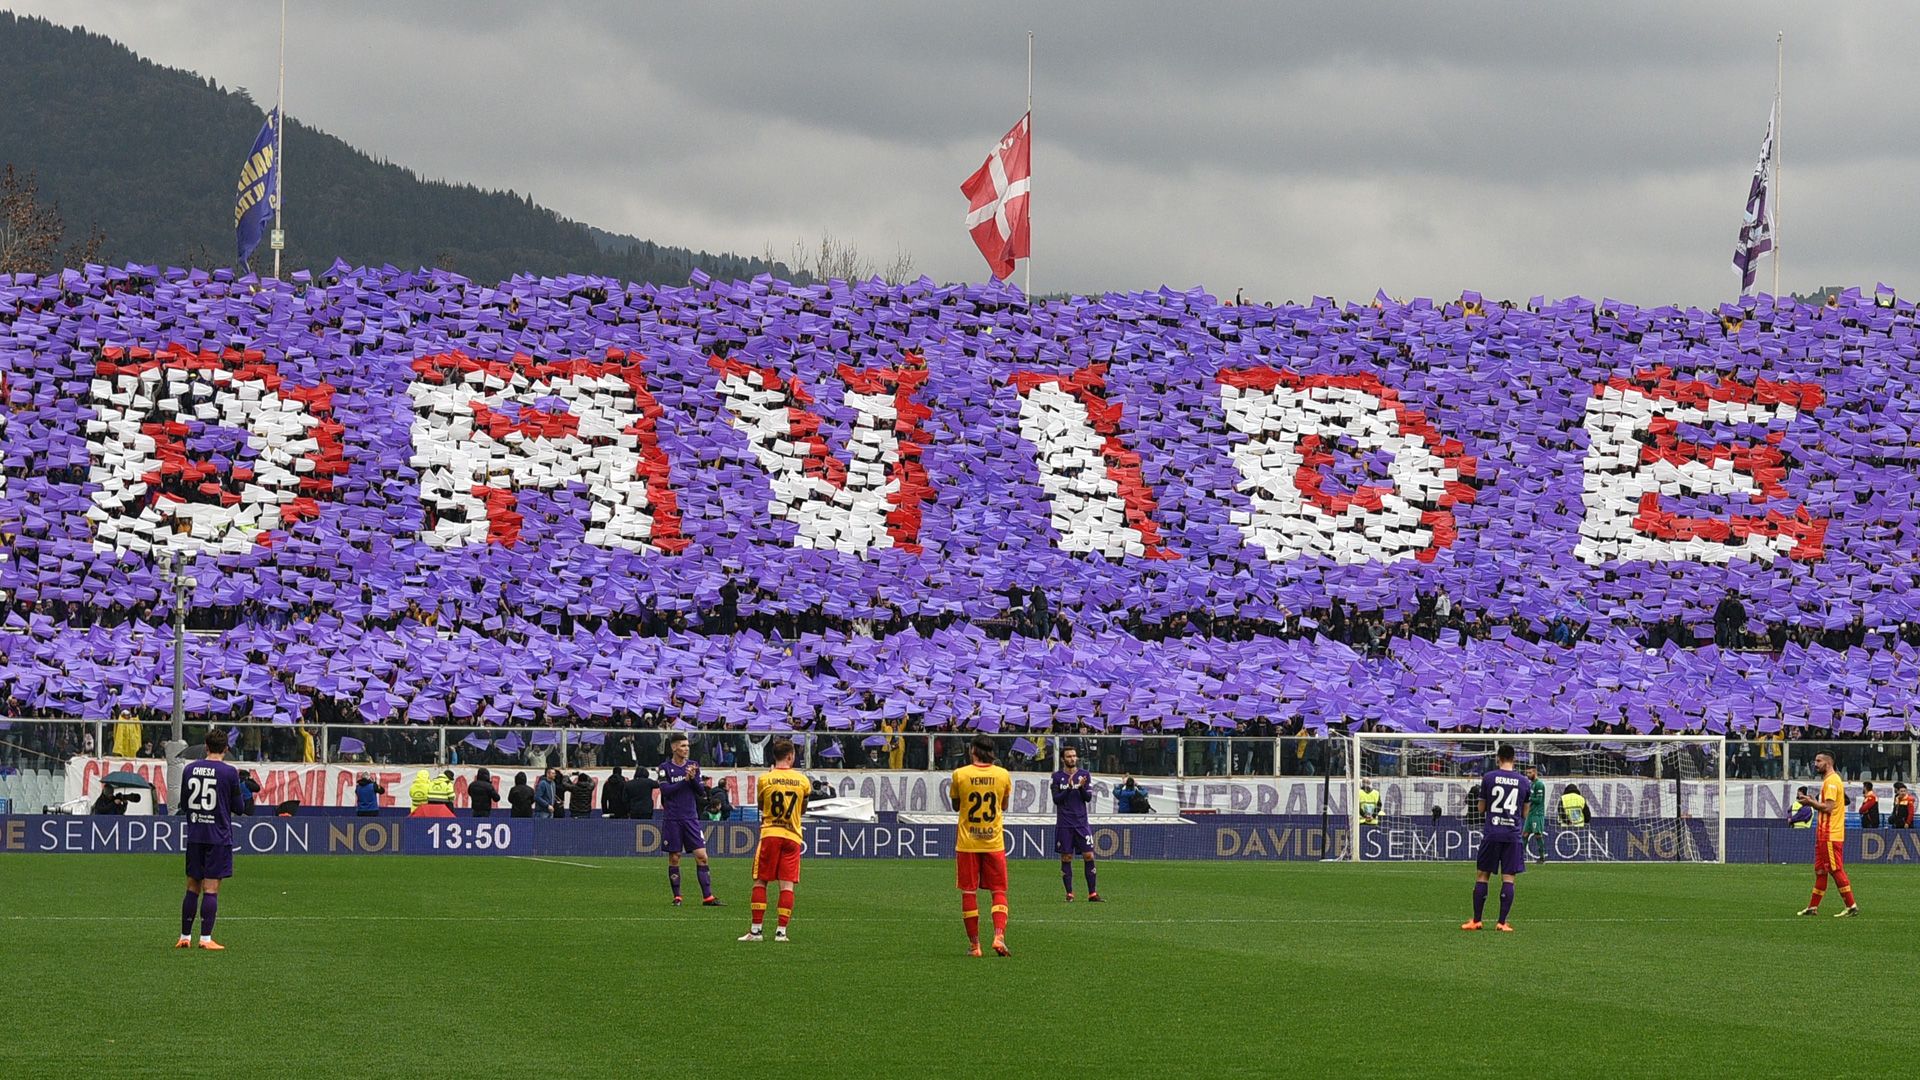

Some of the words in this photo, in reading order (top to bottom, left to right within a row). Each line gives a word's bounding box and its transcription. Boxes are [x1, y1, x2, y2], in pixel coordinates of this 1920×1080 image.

[193, 767, 215, 777] CHIESA
[768, 778, 800, 786] LOMBARDI
[970, 777, 995, 785] VENUTI
[1495, 776, 1519, 786] BENASSI
[188, 777, 217, 811] 25
[337, 770, 401, 808] CE
[1744, 784, 1792, 818] IN
[771, 791, 798, 819] 87
[968, 791, 996, 823] 23
[1491, 786, 1519, 815] 24
[329, 823, 400, 852] NOI
[427, 822, 511, 850] 13:50
[1365, 828, 1484, 858] SEMPR
